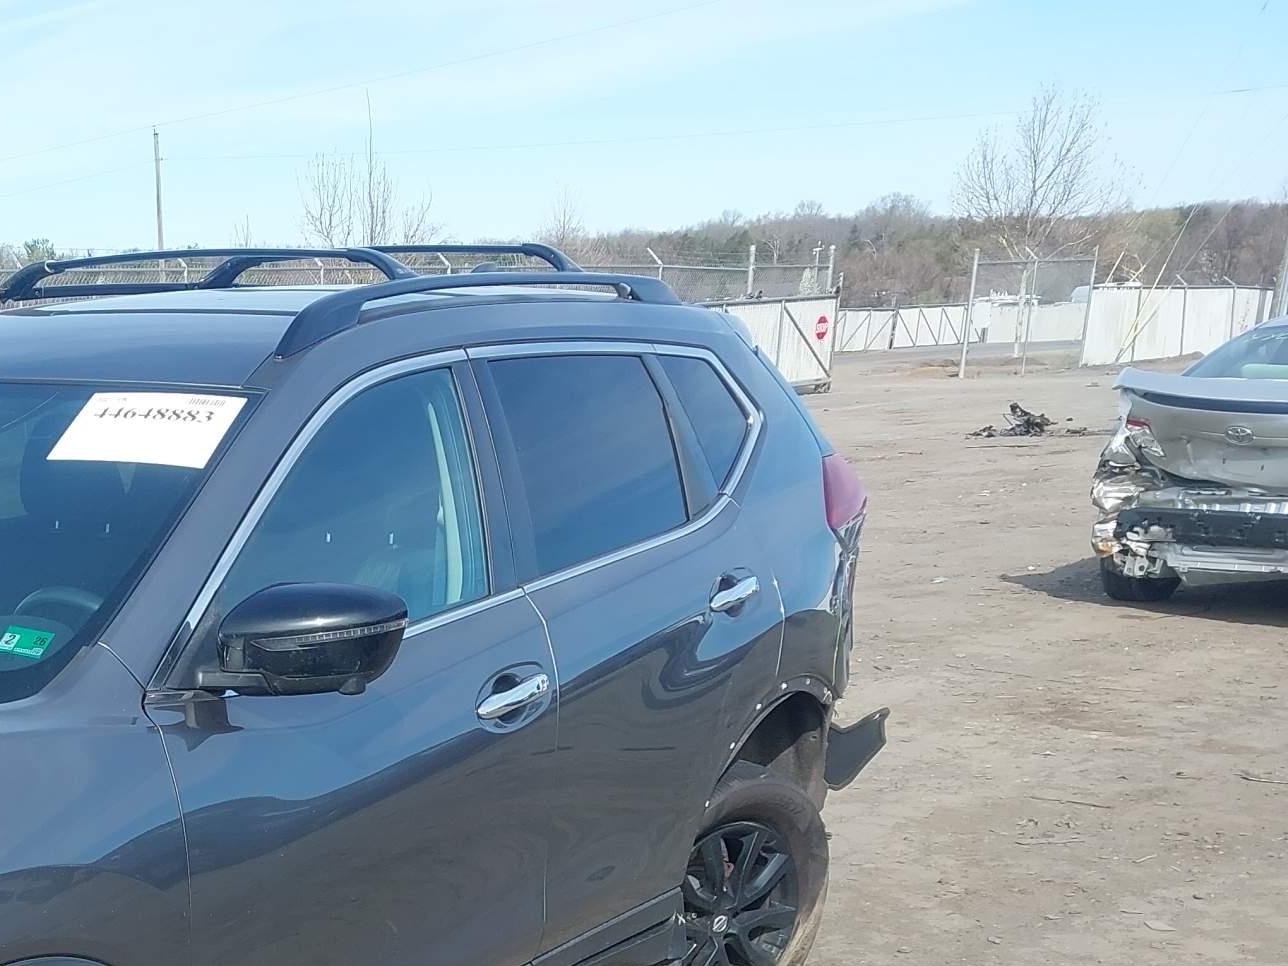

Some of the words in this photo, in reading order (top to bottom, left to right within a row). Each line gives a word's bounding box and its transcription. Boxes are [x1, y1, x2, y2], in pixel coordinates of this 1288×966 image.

[94, 406, 216, 423] 44648883
[4, 634, 17, 646] 2
[33, 636, 49, 647] 26
